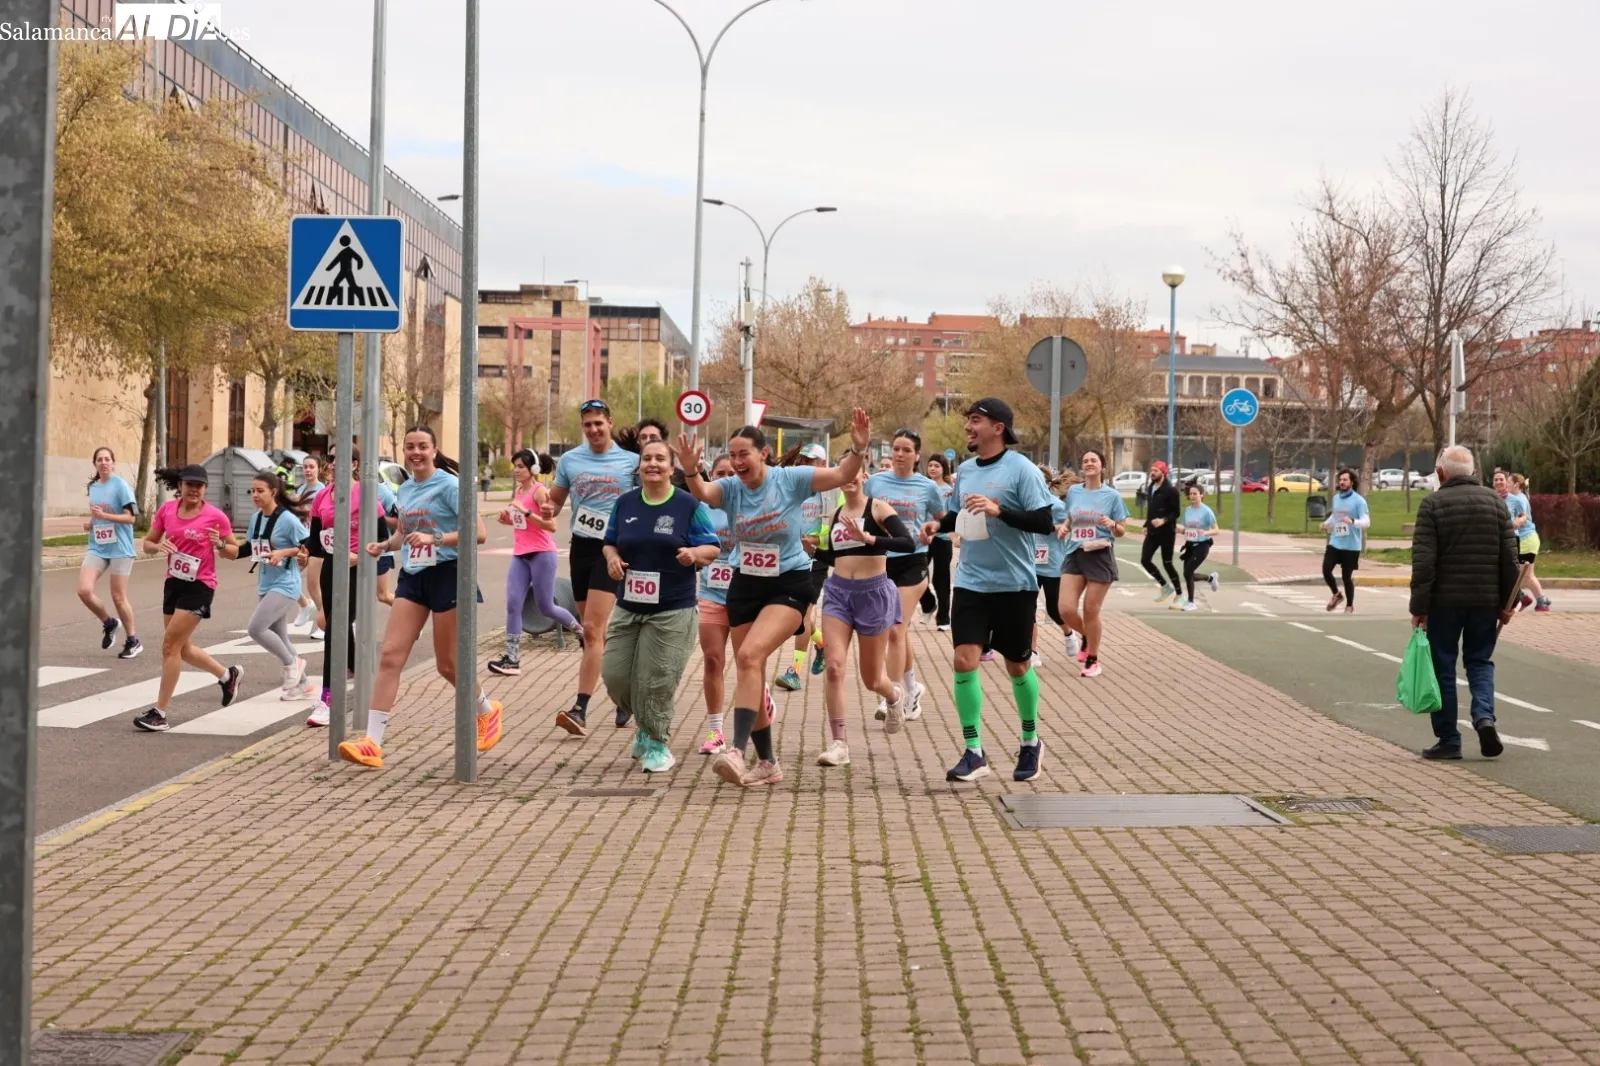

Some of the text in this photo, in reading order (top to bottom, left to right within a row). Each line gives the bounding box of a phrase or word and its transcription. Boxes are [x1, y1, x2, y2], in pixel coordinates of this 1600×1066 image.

[684, 402, 703, 414] 30
[577, 513, 606, 532] 449
[95, 529, 114, 540] 267
[1073, 528, 1095, 539] 189
[743, 551, 777, 568] 262
[1034, 549, 1048, 559] 27
[174, 559, 191, 574] 66
[710, 567, 731, 581] 26
[627, 579, 657, 595] 150
